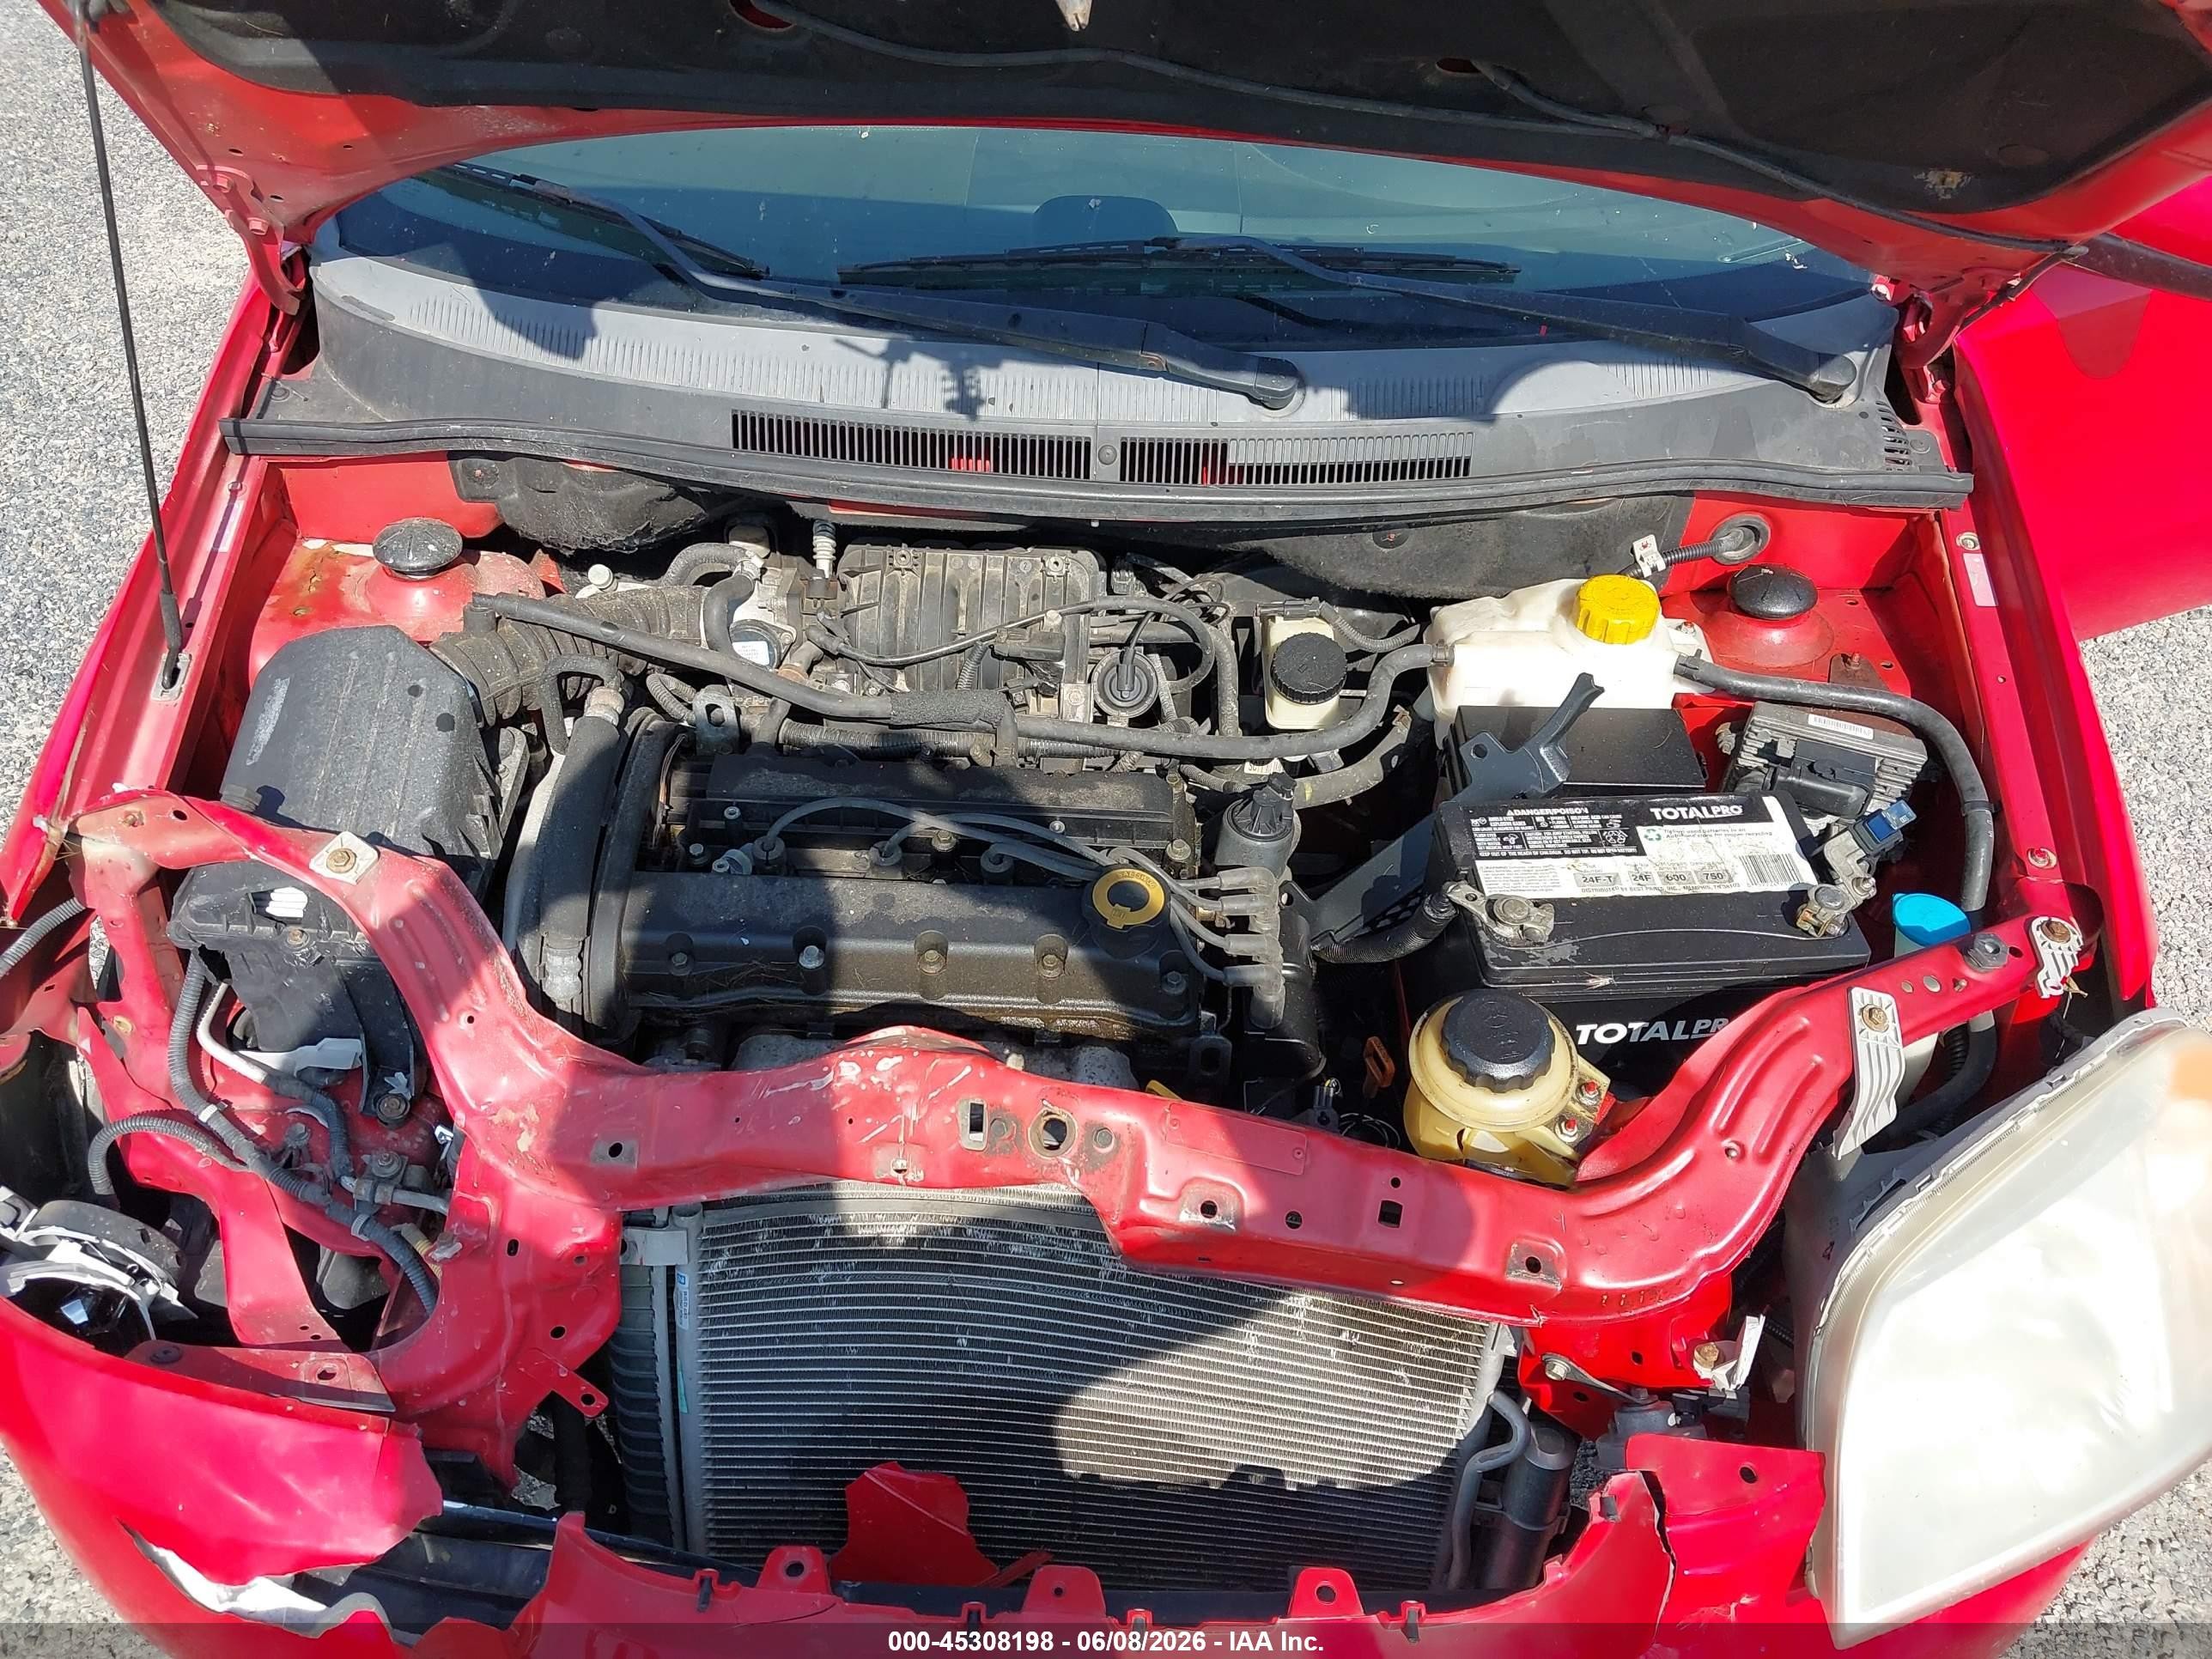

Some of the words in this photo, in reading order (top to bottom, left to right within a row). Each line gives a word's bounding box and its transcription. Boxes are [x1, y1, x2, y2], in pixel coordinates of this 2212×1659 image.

[1650, 805, 1743, 820] TOTALPRO
[1582, 875, 1613, 884] 24F-T
[1576, 1018, 1729, 1045] TOTALPR
